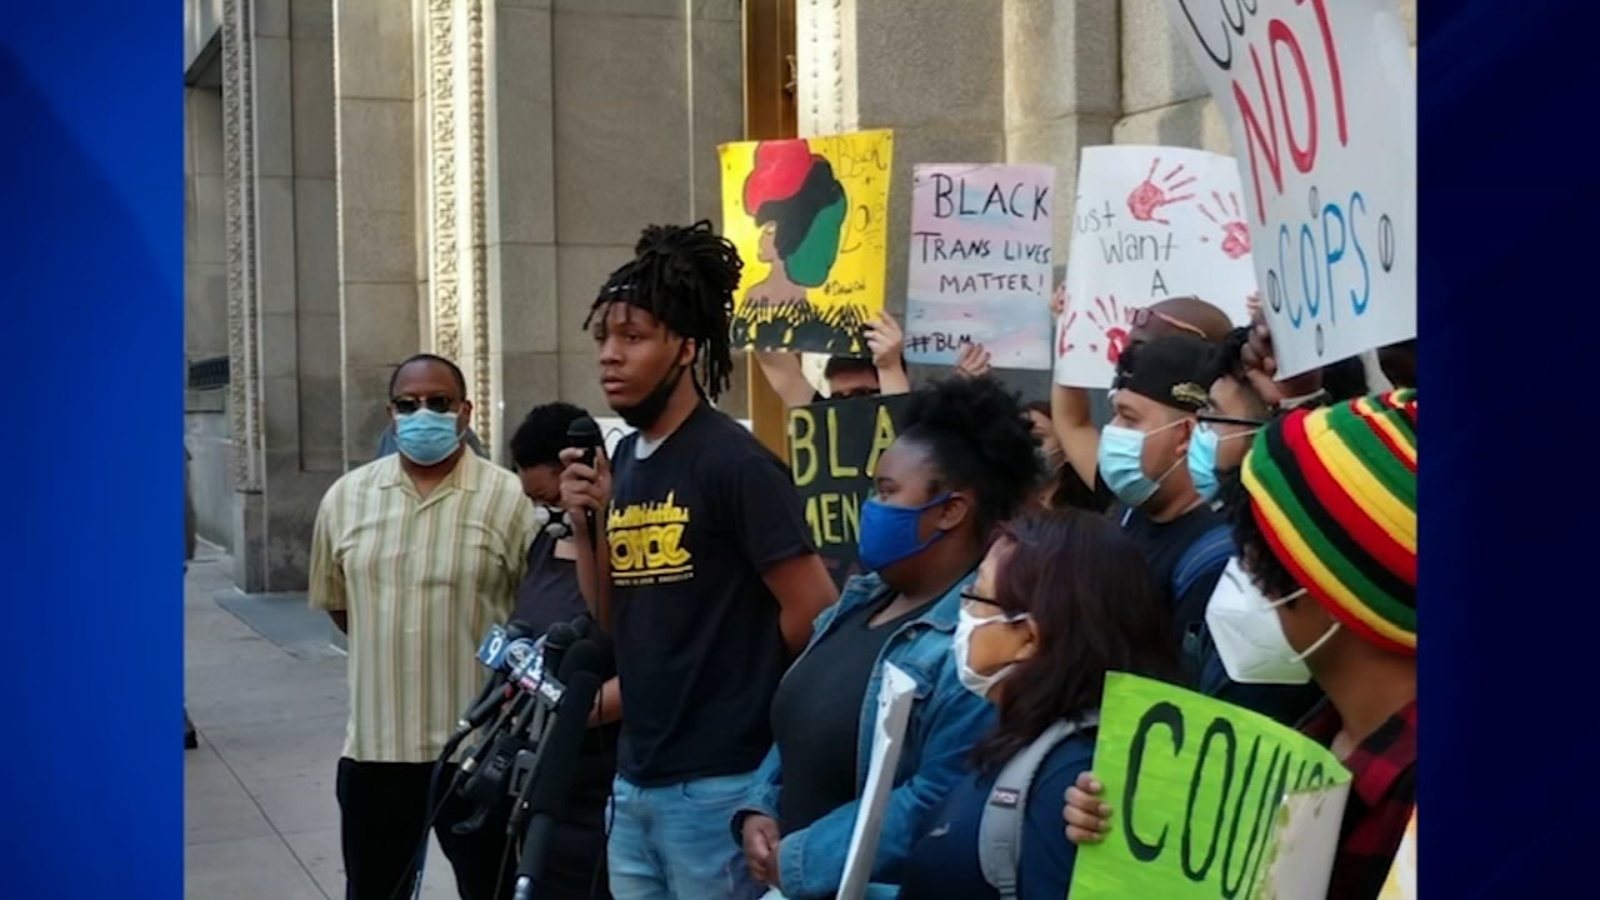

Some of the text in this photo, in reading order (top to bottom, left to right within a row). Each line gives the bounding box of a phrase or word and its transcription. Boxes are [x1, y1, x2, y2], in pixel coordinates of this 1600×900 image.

[1232, 0, 1348, 227] NOT
[931, 173, 1049, 221] BLACK
[914, 232, 1052, 265] TRANS LIVES
[1100, 230, 1180, 263] Want
[1279, 191, 1371, 328] COPS
[940, 273, 1045, 296] MATTER!
[1151, 269, 1169, 297] A
[486, 636, 503, 665] 9
